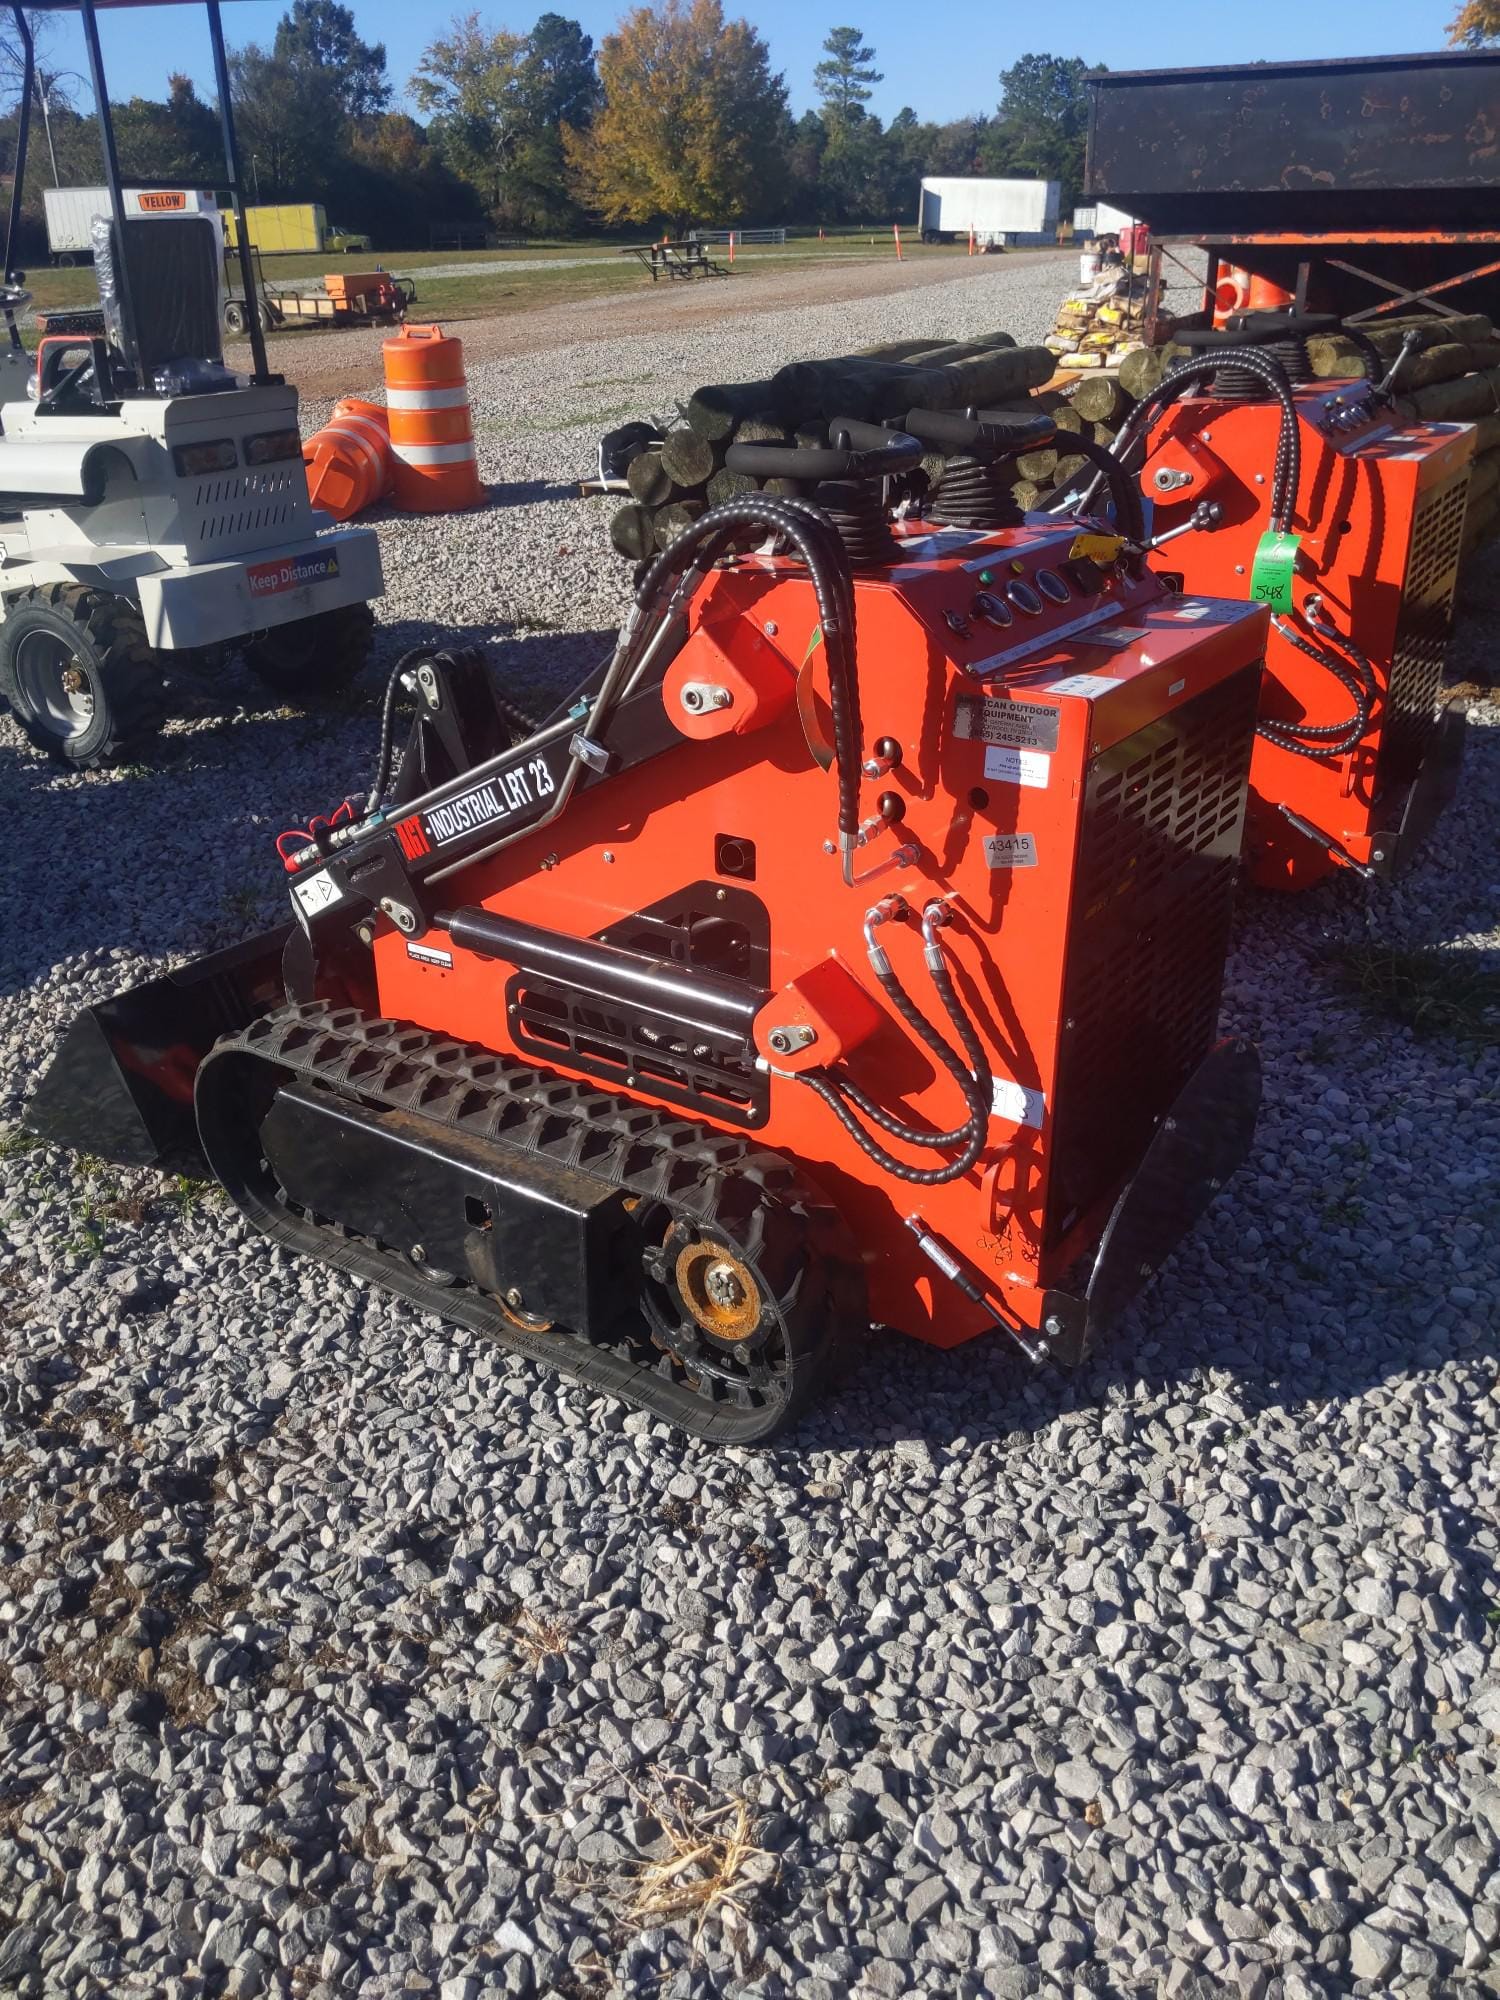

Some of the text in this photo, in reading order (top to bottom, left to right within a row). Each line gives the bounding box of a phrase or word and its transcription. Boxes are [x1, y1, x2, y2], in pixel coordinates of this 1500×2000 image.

[144, 195, 180, 208] YELLOW
[249, 561, 326, 590] Keep Distance
[1255, 583, 1285, 600] 548
[976, 708, 1034, 723] QUIPMENT
[1009, 703, 1058, 718] OUTDOOR
[996, 732, 1038, 746] 245-5213
[428, 785, 504, 841] INDUSTRIAL
[498, 766, 534, 811] LRT
[528, 758, 555, 798] 23
[988, 838, 1029, 852] 43415
